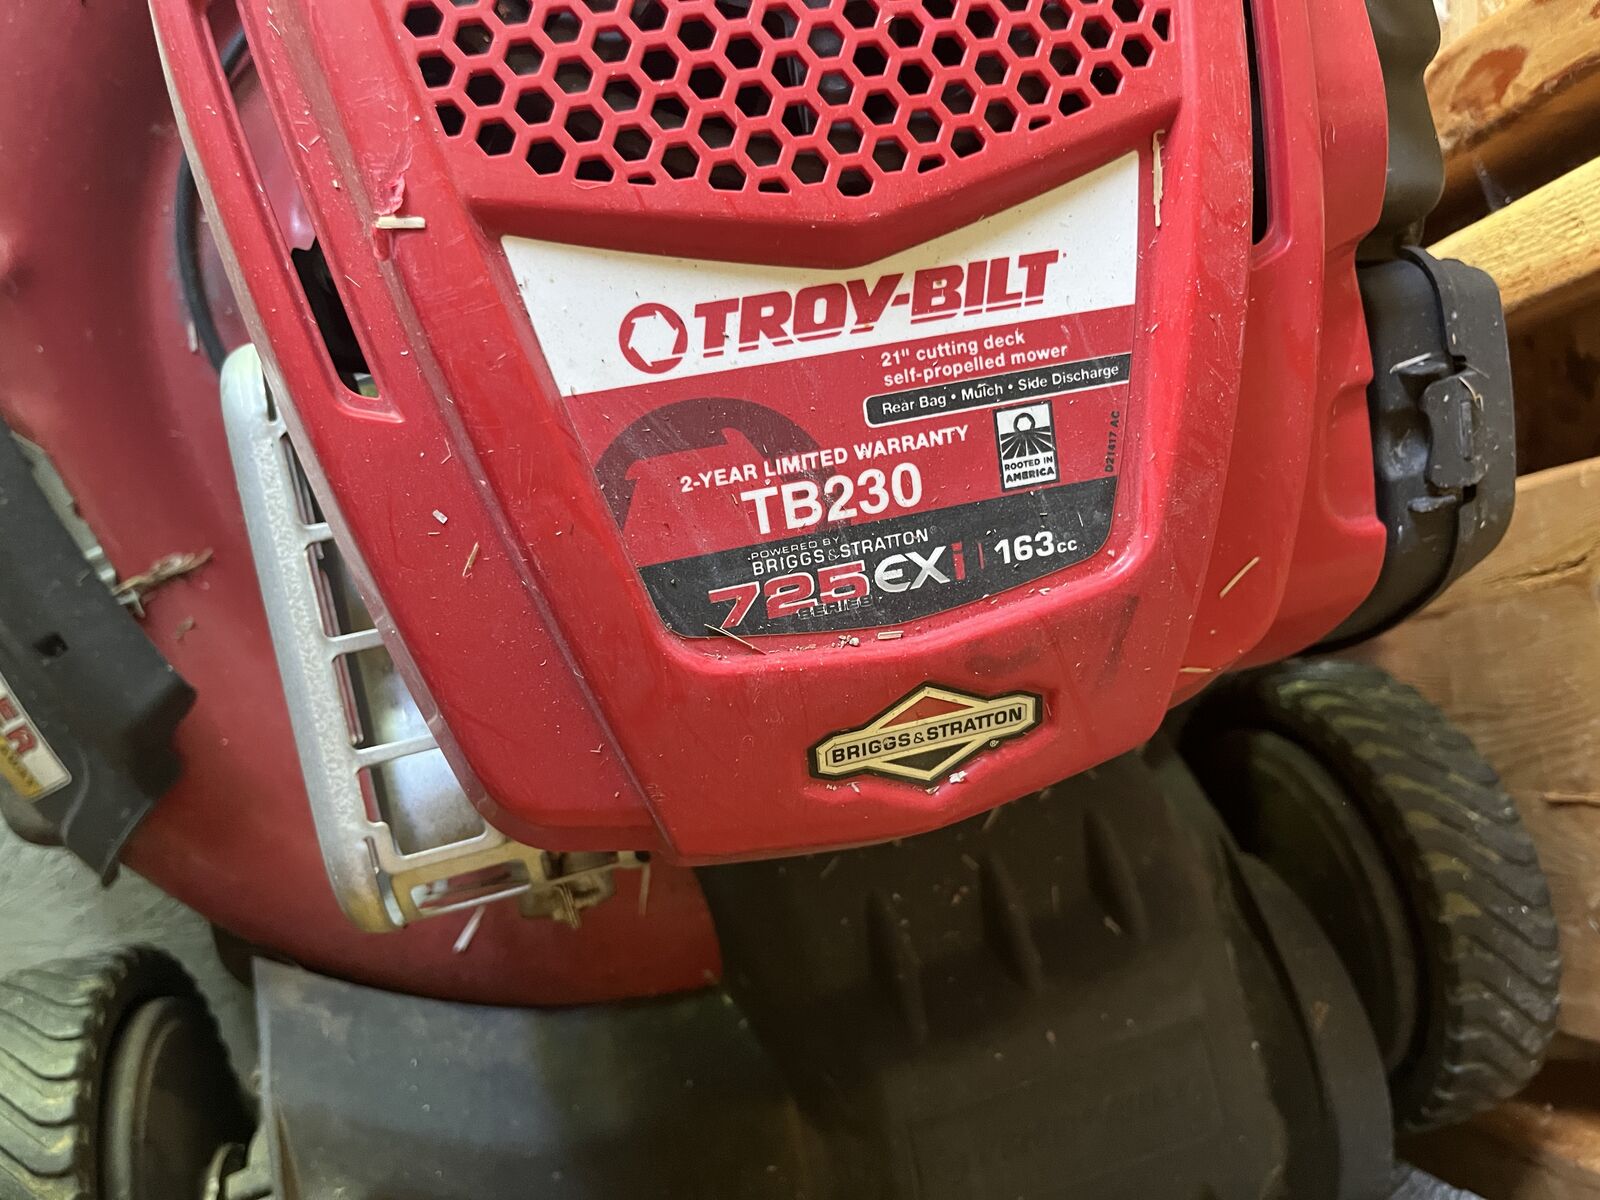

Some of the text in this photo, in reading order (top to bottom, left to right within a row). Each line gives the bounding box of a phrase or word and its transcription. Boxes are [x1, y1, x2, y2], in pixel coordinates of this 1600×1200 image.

[693, 250, 1060, 358] TROY-BILT
[881, 331, 1025, 368] 21" cutting deck
[884, 345, 1067, 387] self-propelled mower
[882, 364, 1119, 415] Rear Bag Mulch Side Discharge
[1110, 410, 1120, 428] AC
[680, 425, 969, 493] 2-YEAR LIMITED WARRANTY
[1004, 456, 1053, 472] ROOTED IN
[1006, 466, 1055, 483] AMERICA
[741, 462, 923, 535] TB230
[751, 537, 840, 559] POWERED BY
